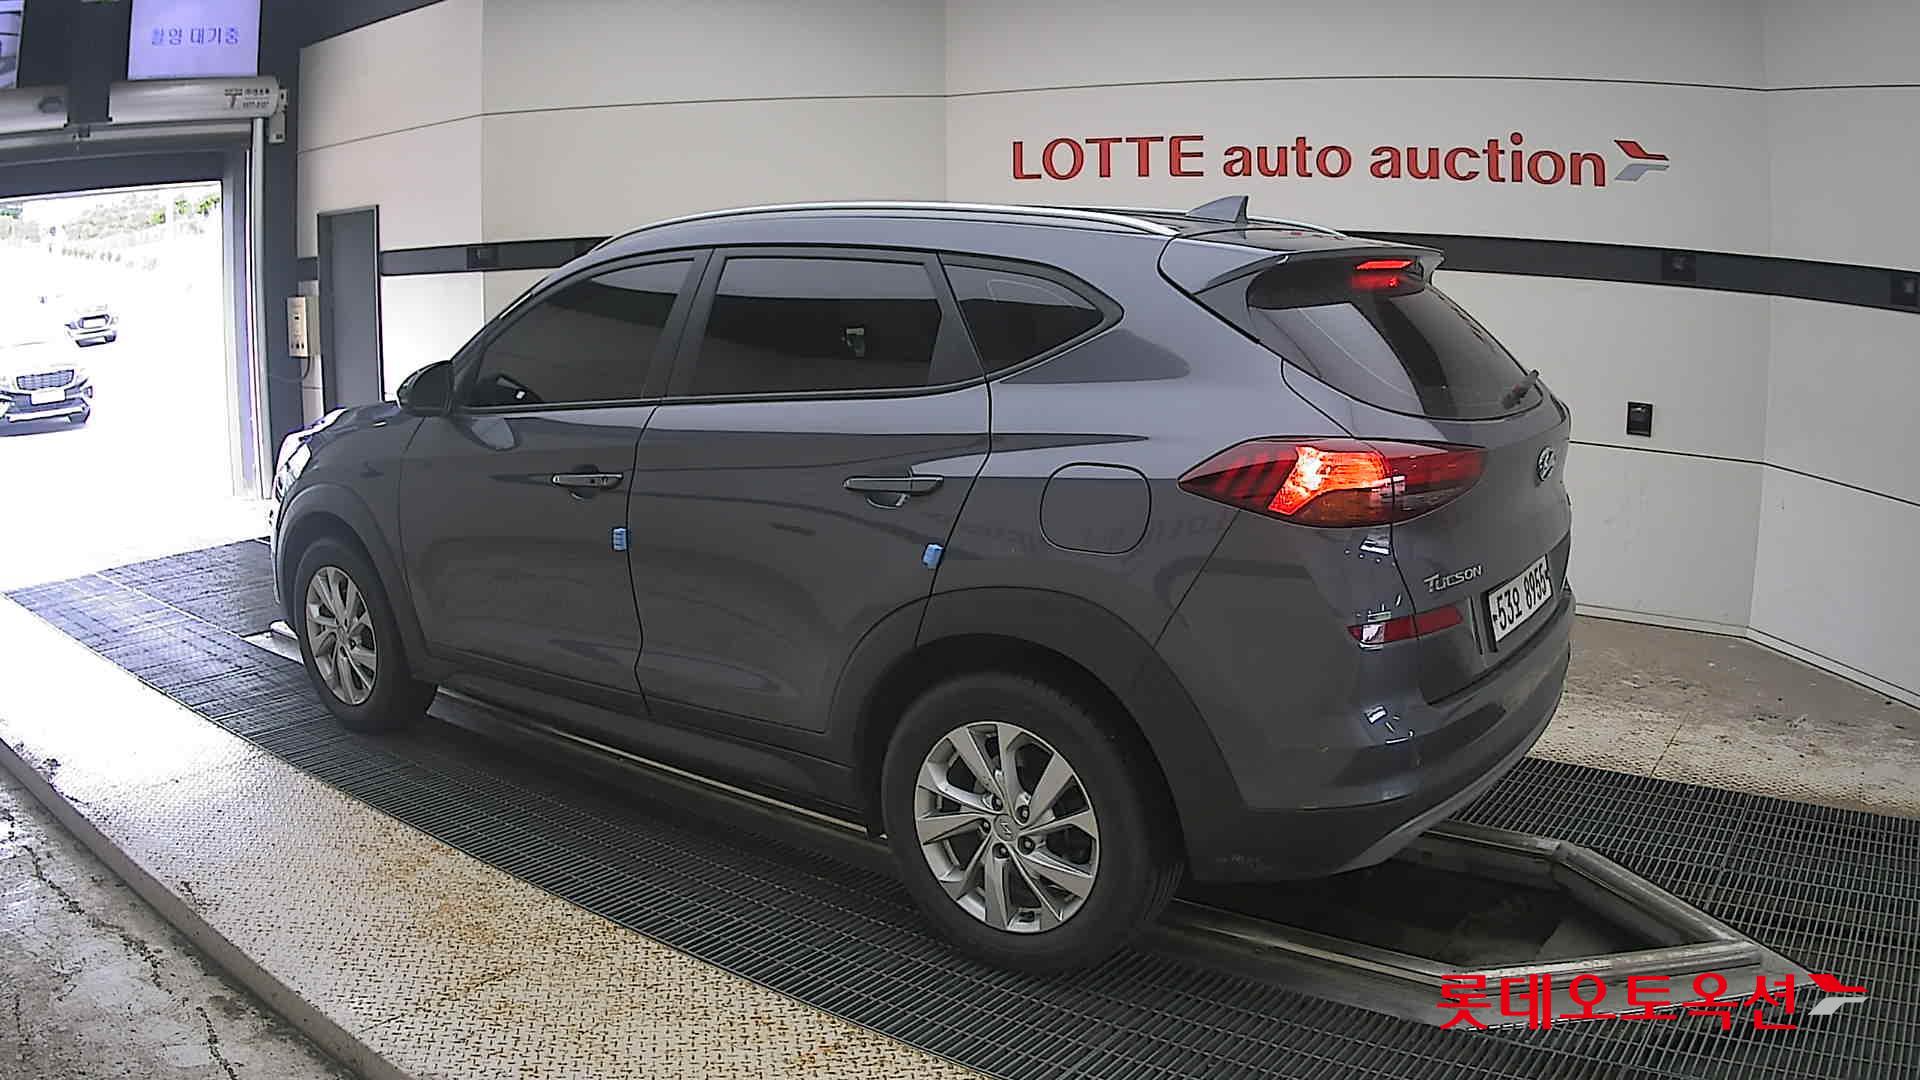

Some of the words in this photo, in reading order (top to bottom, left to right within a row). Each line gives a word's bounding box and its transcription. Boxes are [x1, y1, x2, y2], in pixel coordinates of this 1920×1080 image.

[1012, 134, 1205, 181] LOTTE
[1222, 135, 1353, 179] auto
[1369, 131, 1607, 188] auction
[1423, 564, 1483, 593] TUCSON
[1496, 587, 1522, 631] 53오
[1523, 563, 1547, 610] 8955
